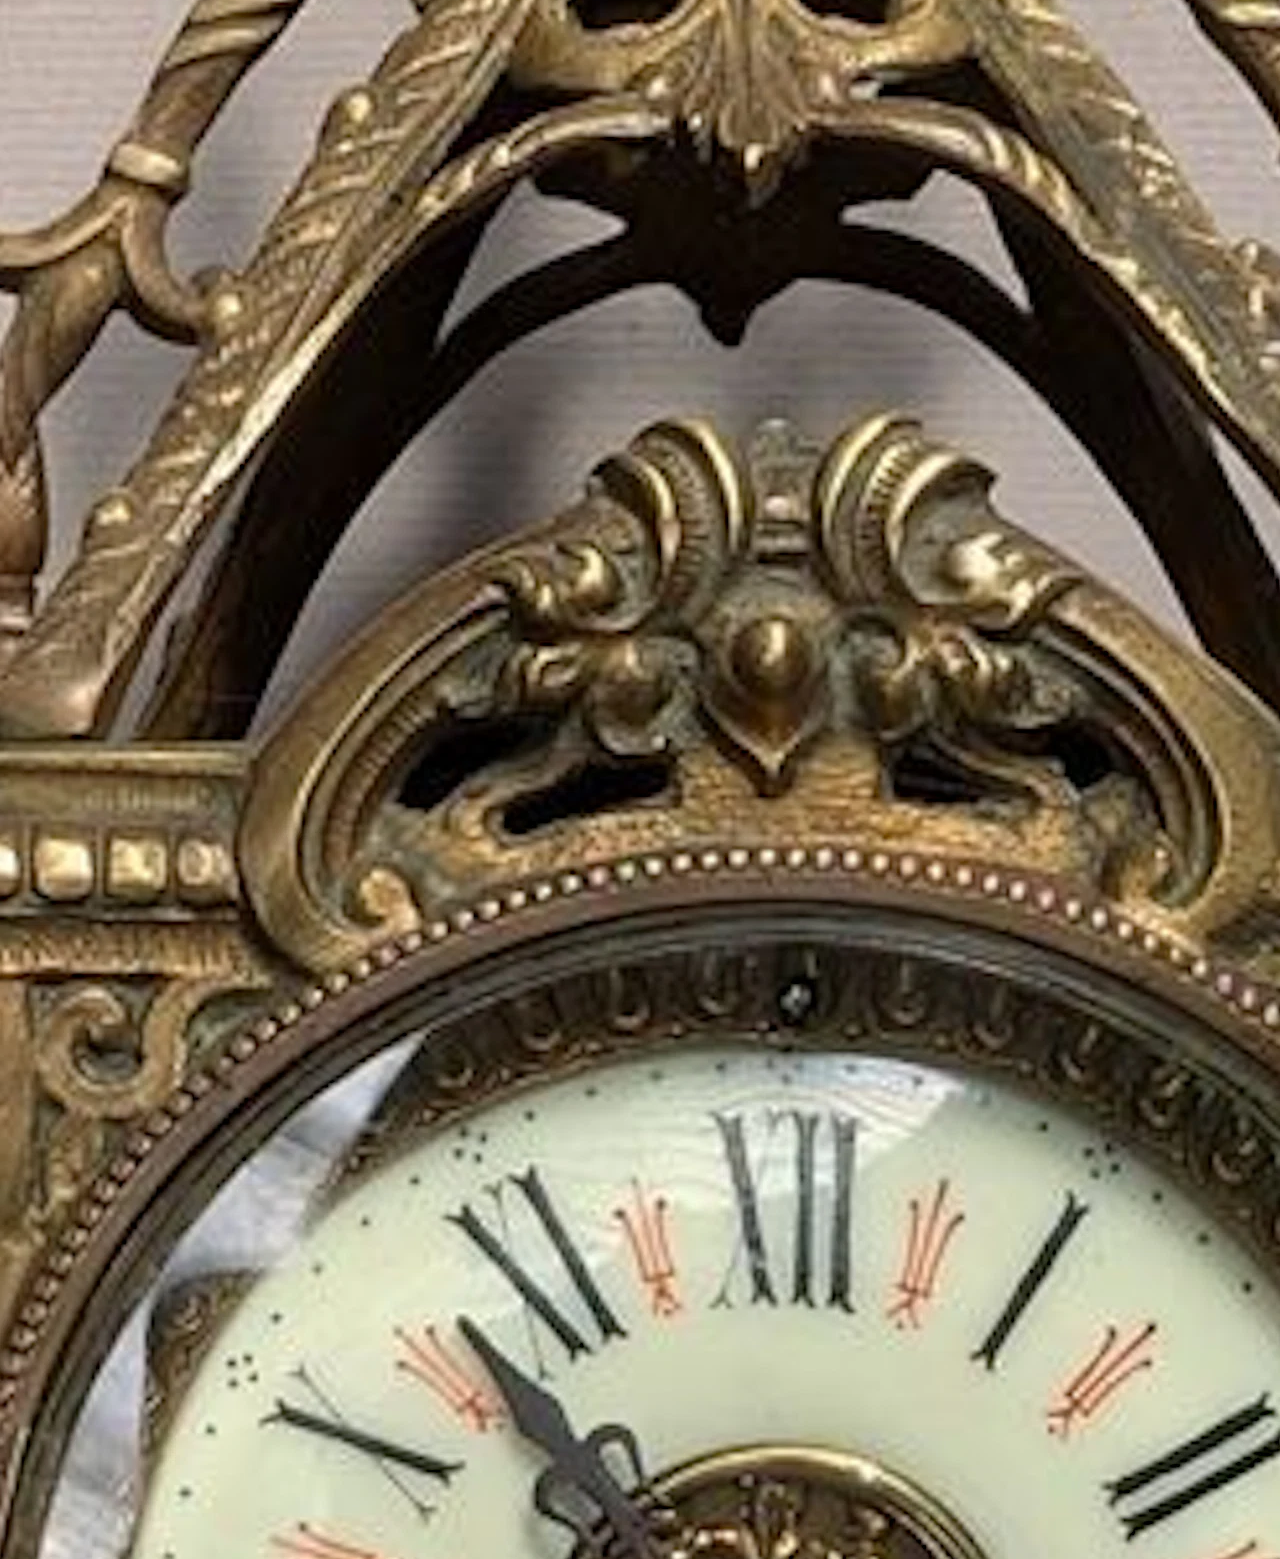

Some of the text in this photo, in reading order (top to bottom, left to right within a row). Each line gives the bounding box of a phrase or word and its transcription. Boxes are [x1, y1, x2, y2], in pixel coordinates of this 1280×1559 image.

[444, 1166, 628, 1381] XI
[710, 1110, 855, 1313] XII
[971, 1191, 1090, 1369] I
[260, 1363, 465, 1521] X
